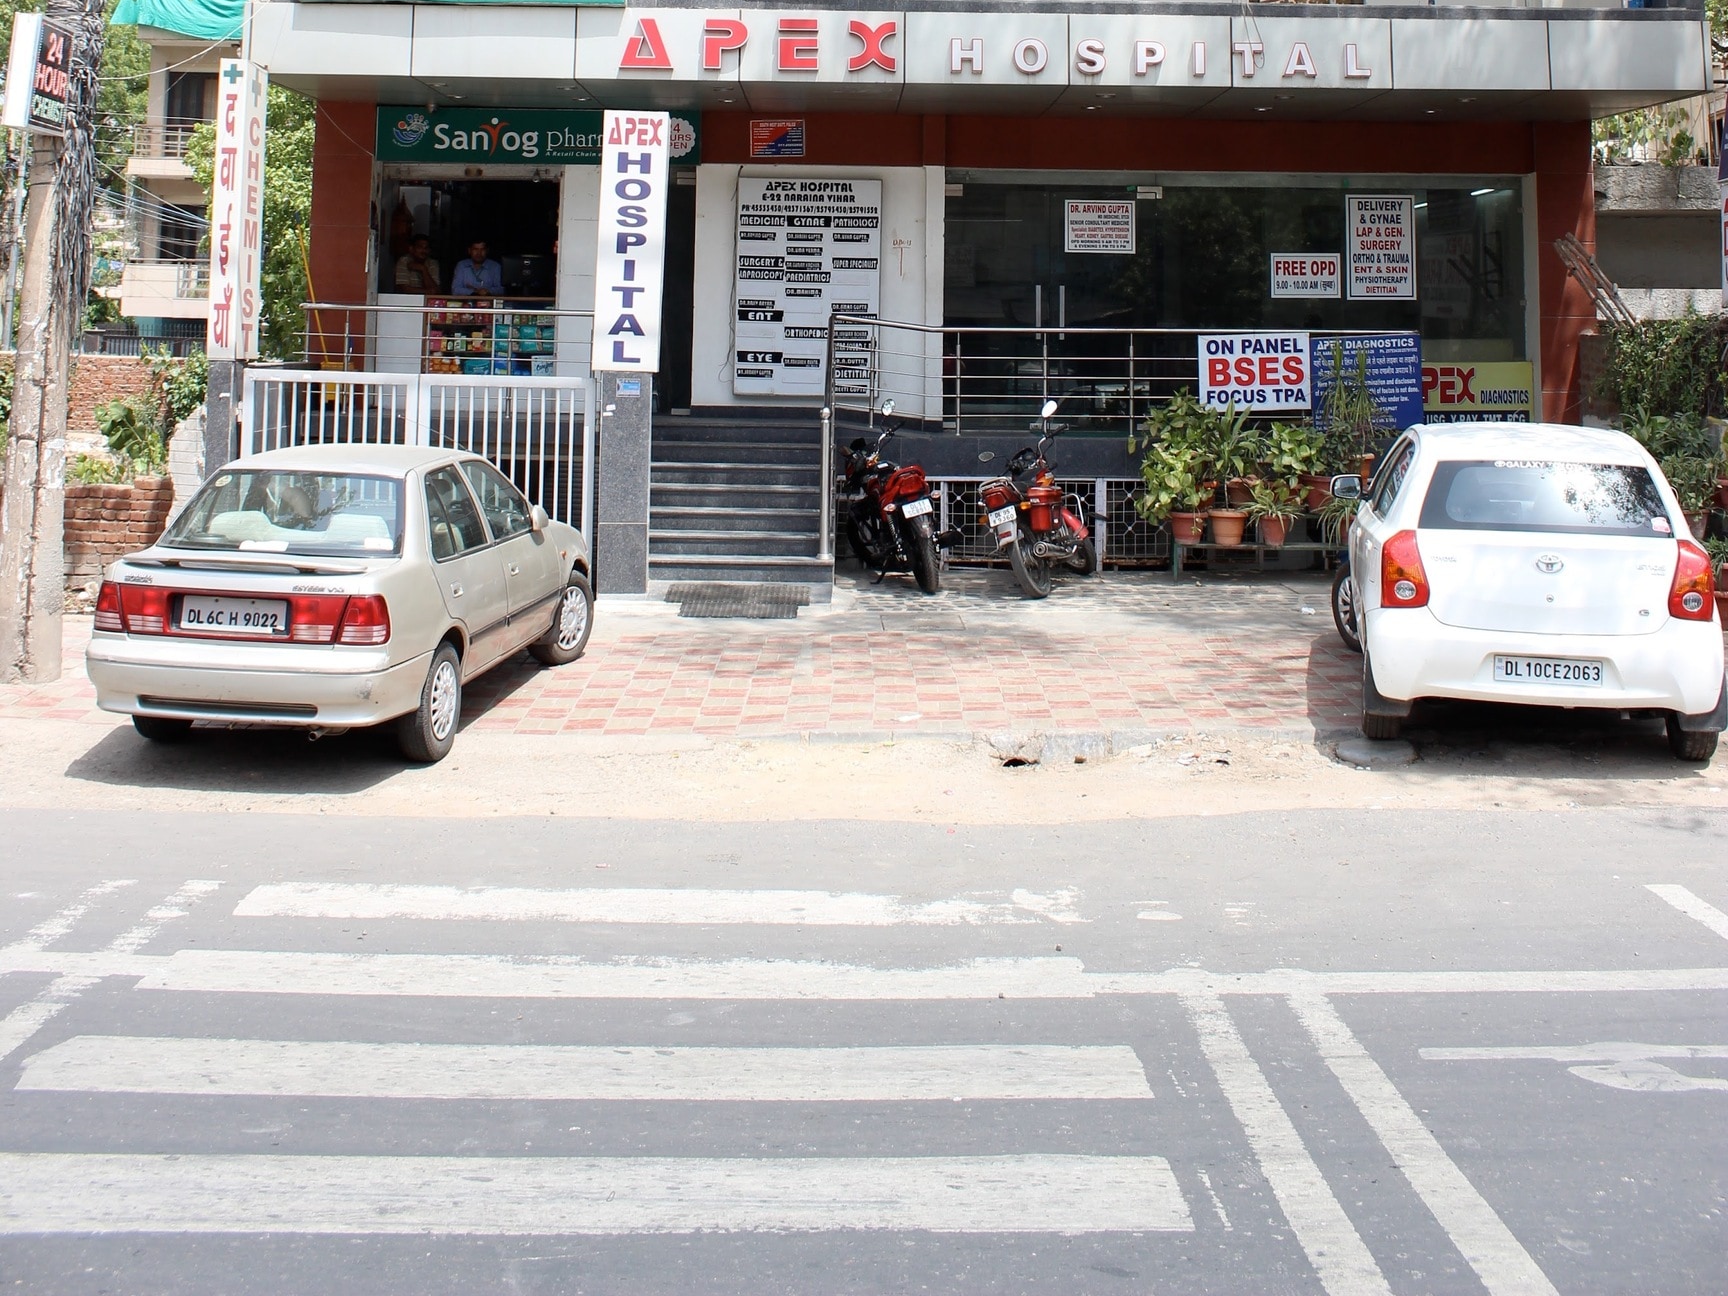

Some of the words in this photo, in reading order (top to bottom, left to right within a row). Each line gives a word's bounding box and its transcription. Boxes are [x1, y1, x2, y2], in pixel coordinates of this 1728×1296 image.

[46, 32, 64, 64] 24
[619, 17, 897, 73] APEX
[949, 36, 1372, 79] HOSPITAL
[35, 62, 67, 98] HOUR
[608, 117, 663, 146] APEX
[765, 181, 796, 191] APEX
[800, 182, 853, 193] HOSPITAL
[762, 193, 781, 202] E-22
[784, 194, 824, 202] NARAINA
[827, 194, 855, 203] VIHAR
[1070, 204, 1080, 213] DR.
[1083, 205, 1106, 214] ARVIND
[1108, 205, 1129, 214] GUPTA
[1357, 200, 1403, 211] DELIVERY
[741, 216, 785, 225] MEDICINE
[794, 217, 825, 226] GYNAE
[834, 218, 877, 227] PATHOLOGY
[1360, 214, 1366, 223] &
[1369, 214, 1402, 225] GYNAE
[241, 116, 261, 353] CHEMIST
[1356, 227, 1373, 237] LAP
[1376, 227, 1382, 237] &
[1384, 227, 1405, 238] GEN.
[1360, 240, 1401, 251] SURGERY
[607, 151, 652, 364] HOSPITAL
[740, 257, 775, 266] SURGERY
[1353, 253, 1375, 264] ORTHO
[1377, 254, 1381, 264] &
[1383, 254, 1409, 264] TRAUMA
[833, 259, 849, 268] SUPER
[1275, 261, 1307, 276] FREE
[1311, 261, 1336, 276] OPD
[740, 270, 783, 279] LAPROSCOPY
[786, 272, 830, 282] PAEDIATRICS
[1355, 276, 1408, 284] PHYSIOTHERAPY
[1276, 280, 1289, 289] 9.00
[1293, 281, 1308, 289] 10.00
[1309, 281, 1318, 289] AM
[1366, 286, 1397, 294] DIETITIAN
[748, 312, 774, 321] ENT
[1206, 339, 1237, 354] ON
[1241, 337, 1304, 354] PANEL
[1345, 338, 1414, 349] DIAGNOSTICS
[747, 353, 773, 362] EYE
[1208, 356, 1305, 387] BSES
[1422, 367, 1475, 403] PEX
[1480, 390, 1529, 404] DIAGNOSTICS
[1206, 388, 1267, 405] FOCUS
[1274, 387, 1306, 403] TPA
[244, 612, 278, 628] 9022
[1505, 660, 1600, 681] DL10CE2063
